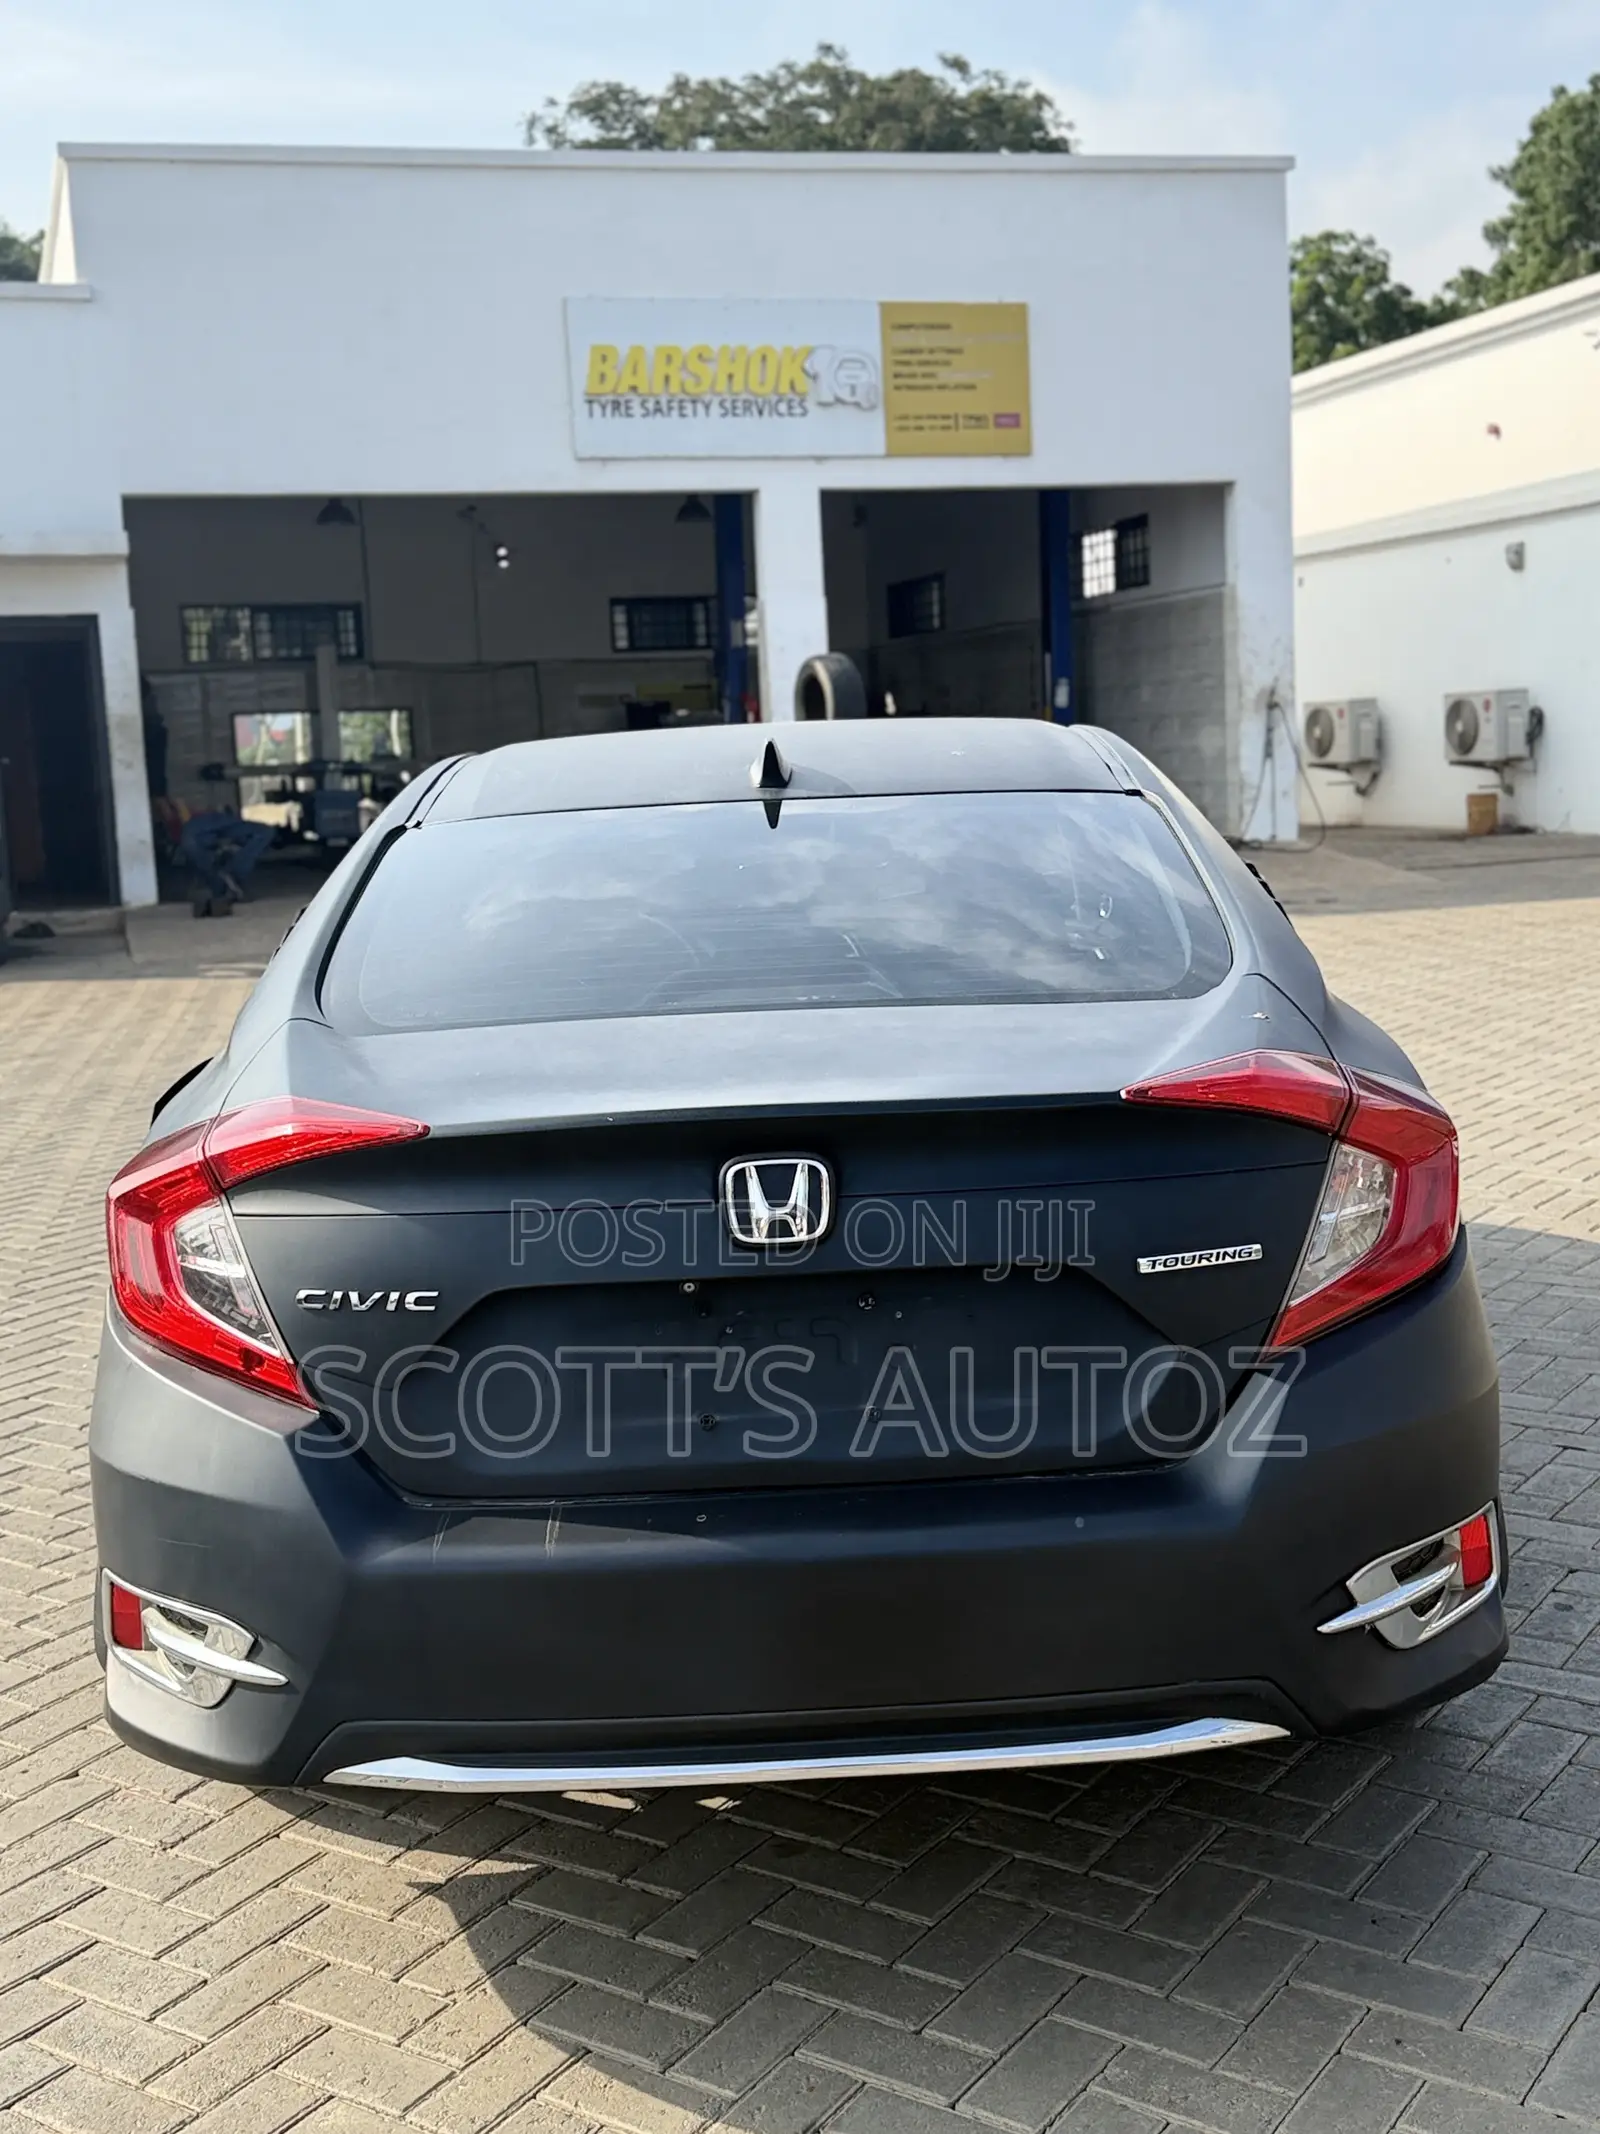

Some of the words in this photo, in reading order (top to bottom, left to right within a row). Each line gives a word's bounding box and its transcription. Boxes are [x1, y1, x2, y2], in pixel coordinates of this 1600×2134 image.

[585, 344, 814, 397] BARSHOK
[585, 398, 635, 419] TYRE
[640, 398, 713, 419] SAFETY
[718, 398, 809, 418] SERVICES
[1146, 1246, 1253, 1270] TOURING
[295, 1289, 440, 1312] CIVIC
